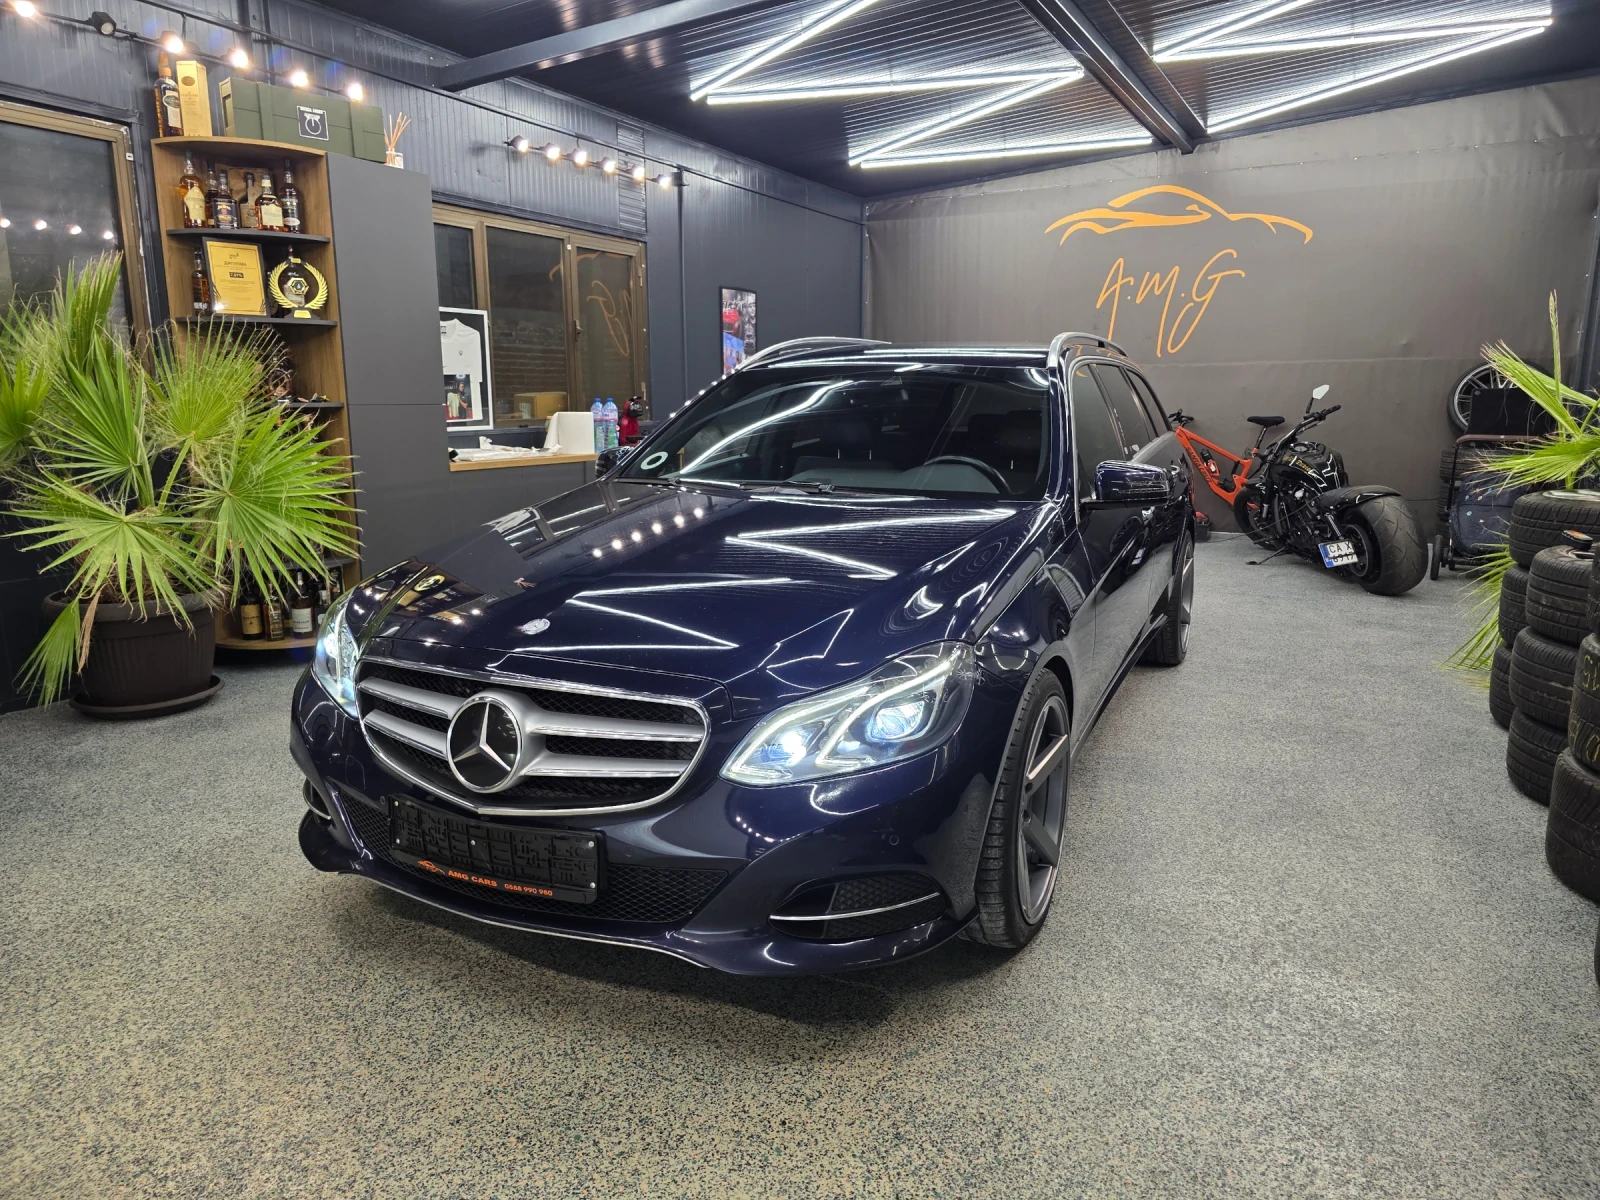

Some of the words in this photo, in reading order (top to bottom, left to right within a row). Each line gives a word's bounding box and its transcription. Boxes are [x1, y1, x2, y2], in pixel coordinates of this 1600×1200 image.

[1329, 543, 1343, 553] CA
[1345, 541, 1352, 550] X
[448, 870, 469, 880] AMG
[471, 876, 497, 887] CARS
[523, 886, 537, 894] 990
